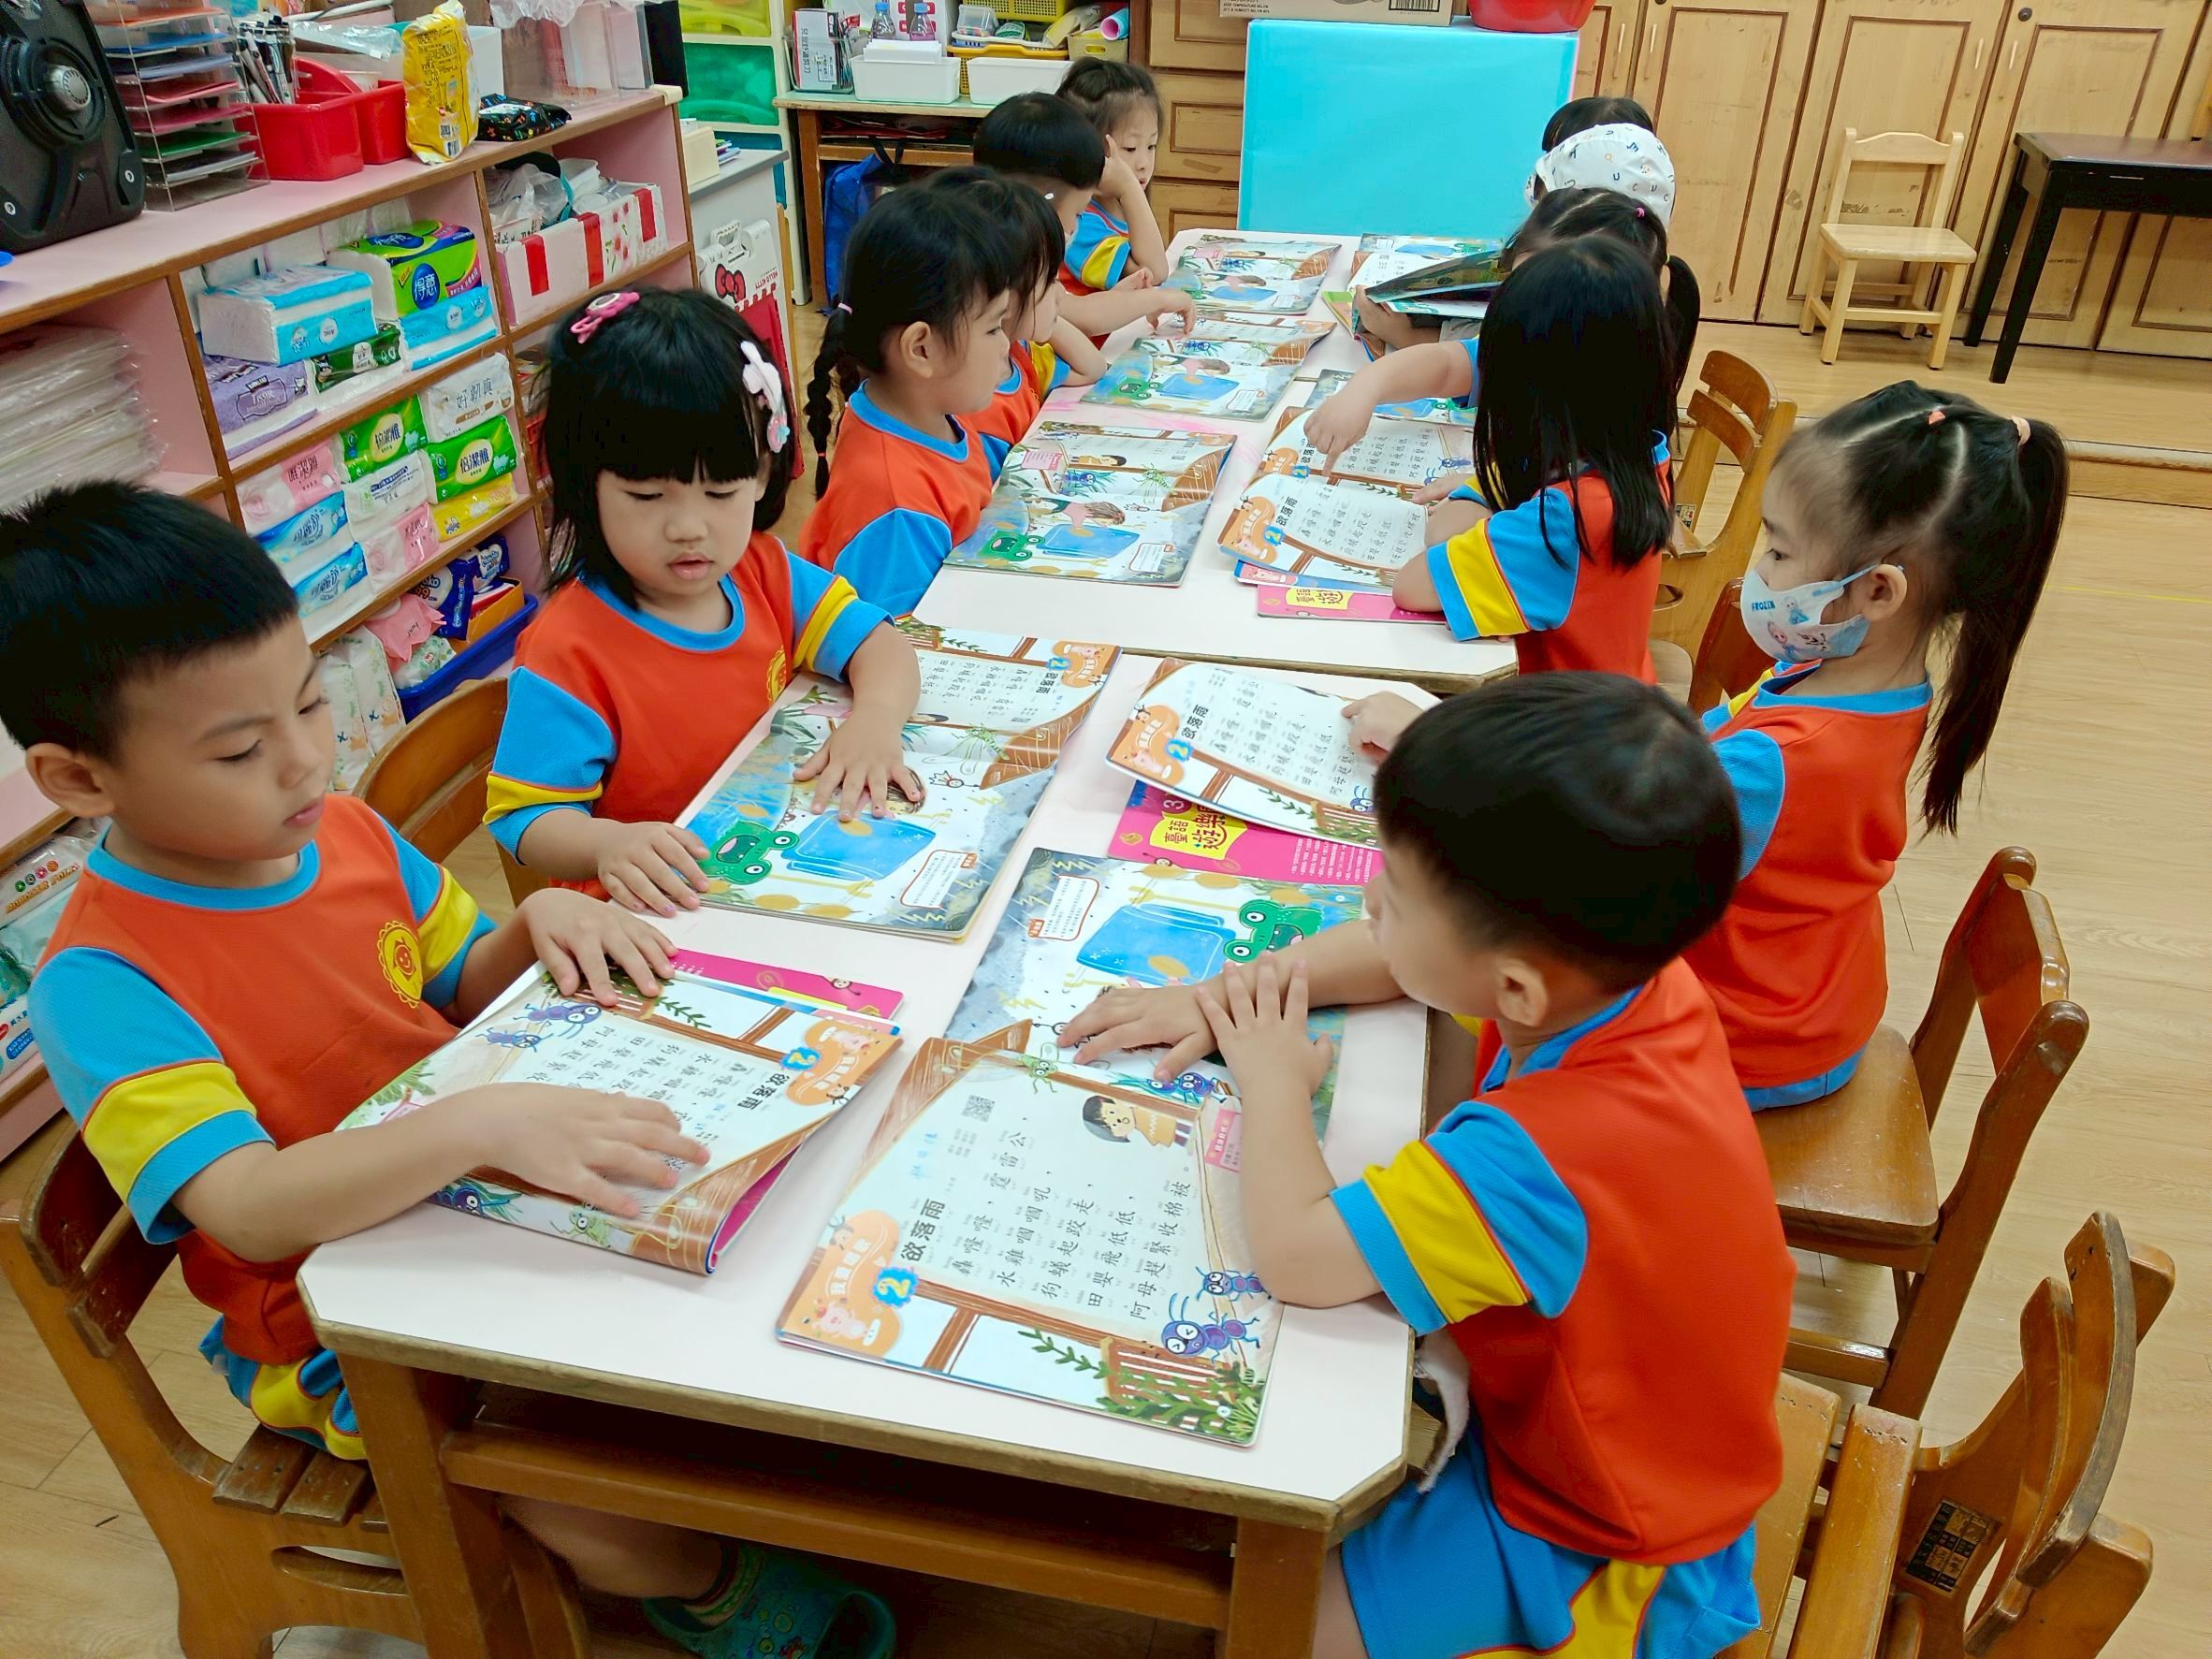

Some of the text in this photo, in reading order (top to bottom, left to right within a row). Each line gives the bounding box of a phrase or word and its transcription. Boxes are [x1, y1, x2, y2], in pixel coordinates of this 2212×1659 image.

[414, 273, 438, 300] 得意
[460, 447, 489, 474] 倍潔雅
[1752, 600, 1776, 612] FROZEN
[1181, 704, 1209, 740] 欲落雨
[1163, 799, 1185, 810] 3
[1164, 820, 1188, 844] 臺語
[737, 1073, 790, 1110] 欲落雨
[900, 1199, 946, 1262] 欲落雨
[876, 1276, 911, 1299] 2
